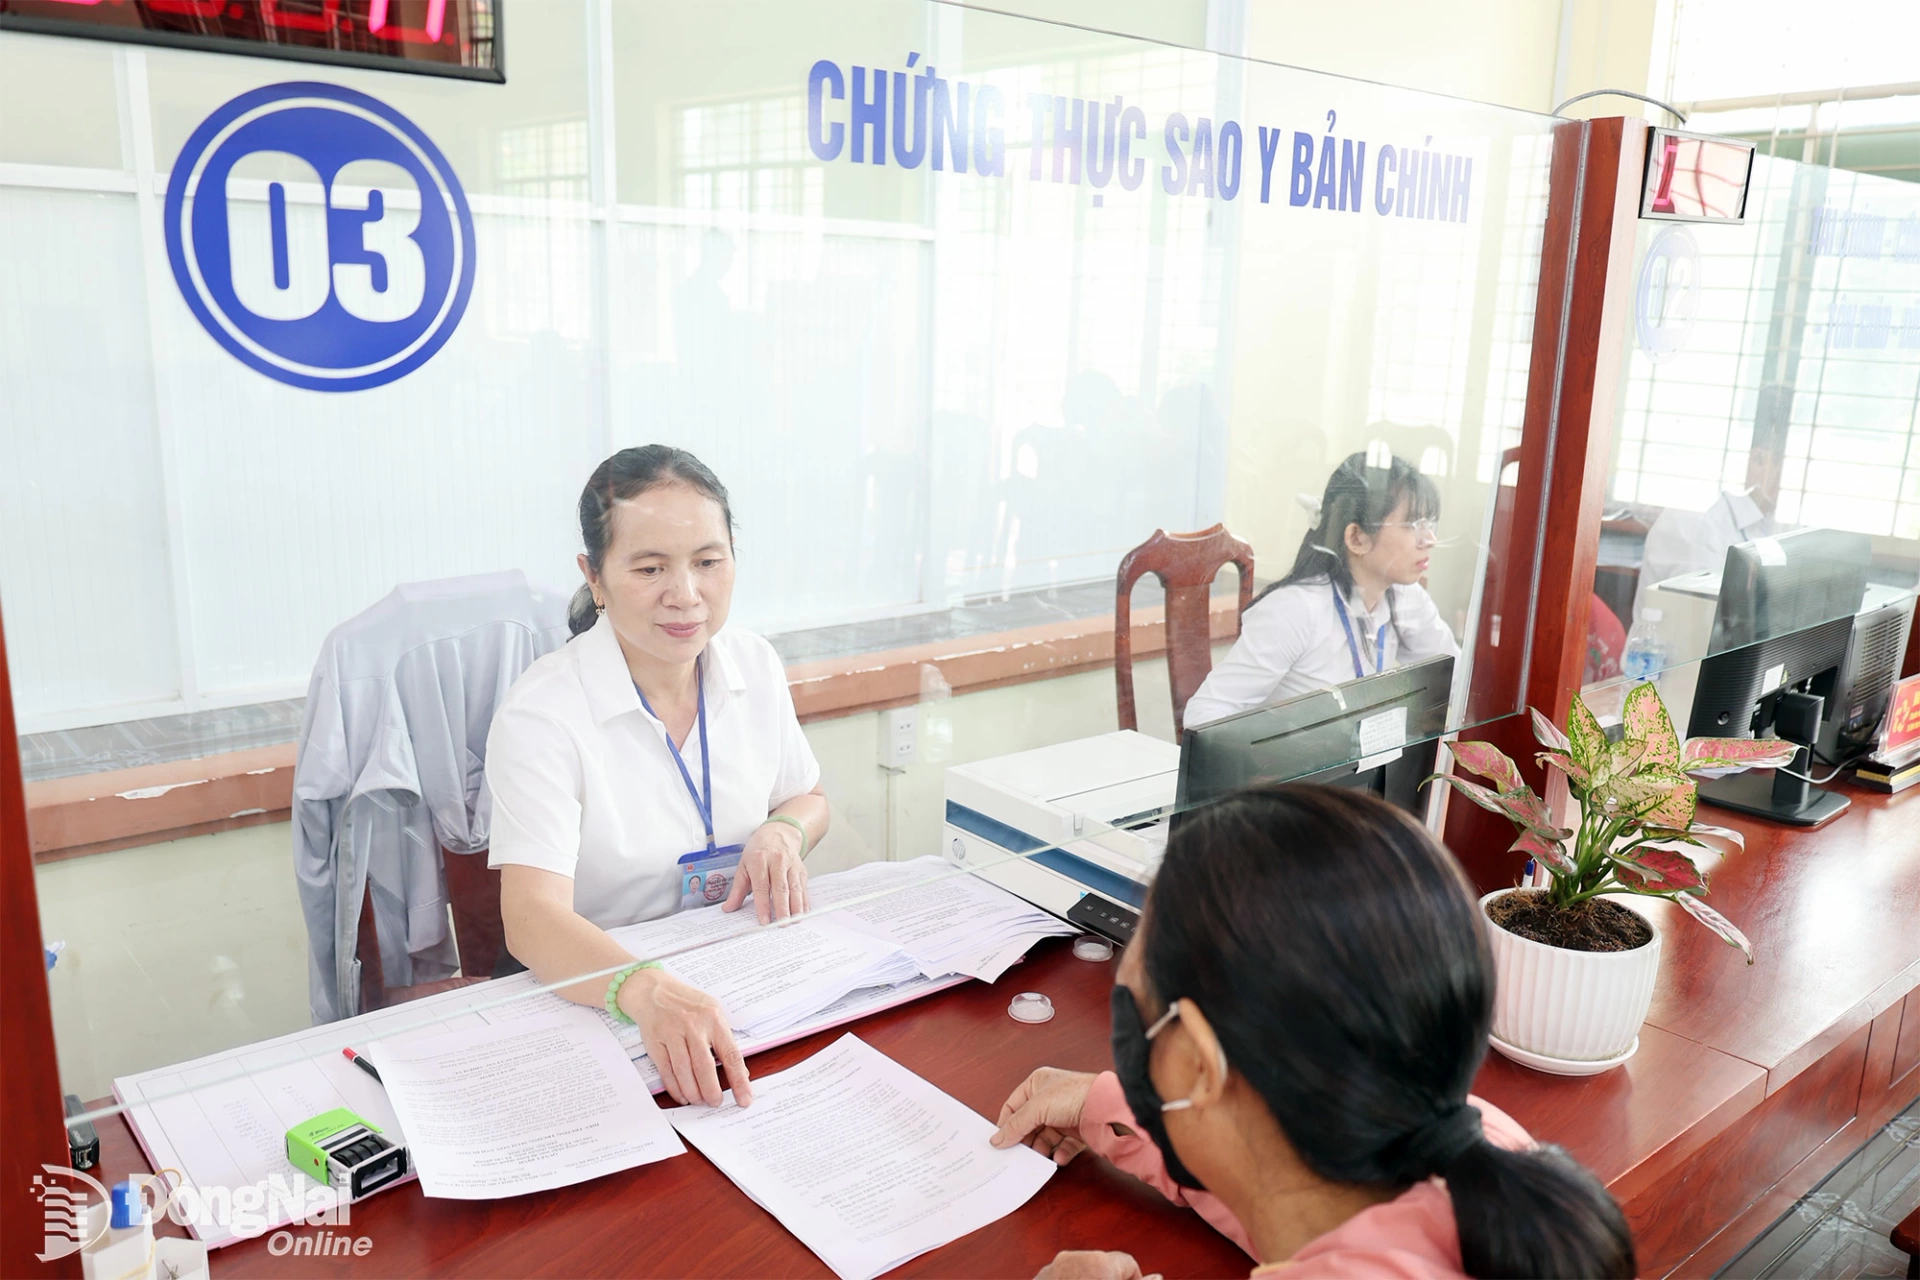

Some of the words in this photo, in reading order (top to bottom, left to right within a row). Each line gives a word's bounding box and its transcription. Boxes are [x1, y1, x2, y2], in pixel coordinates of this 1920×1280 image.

[808, 51, 1006, 178] CHỨNG
[1026, 94, 1147, 208] THỰC
[1161, 112, 1243, 201] SAO
[1257, 125, 1281, 204] Y
[1289, 109, 1366, 213] BẢN
[1375, 135, 1472, 223] CHÍNH
[225, 150, 426, 323] 03
